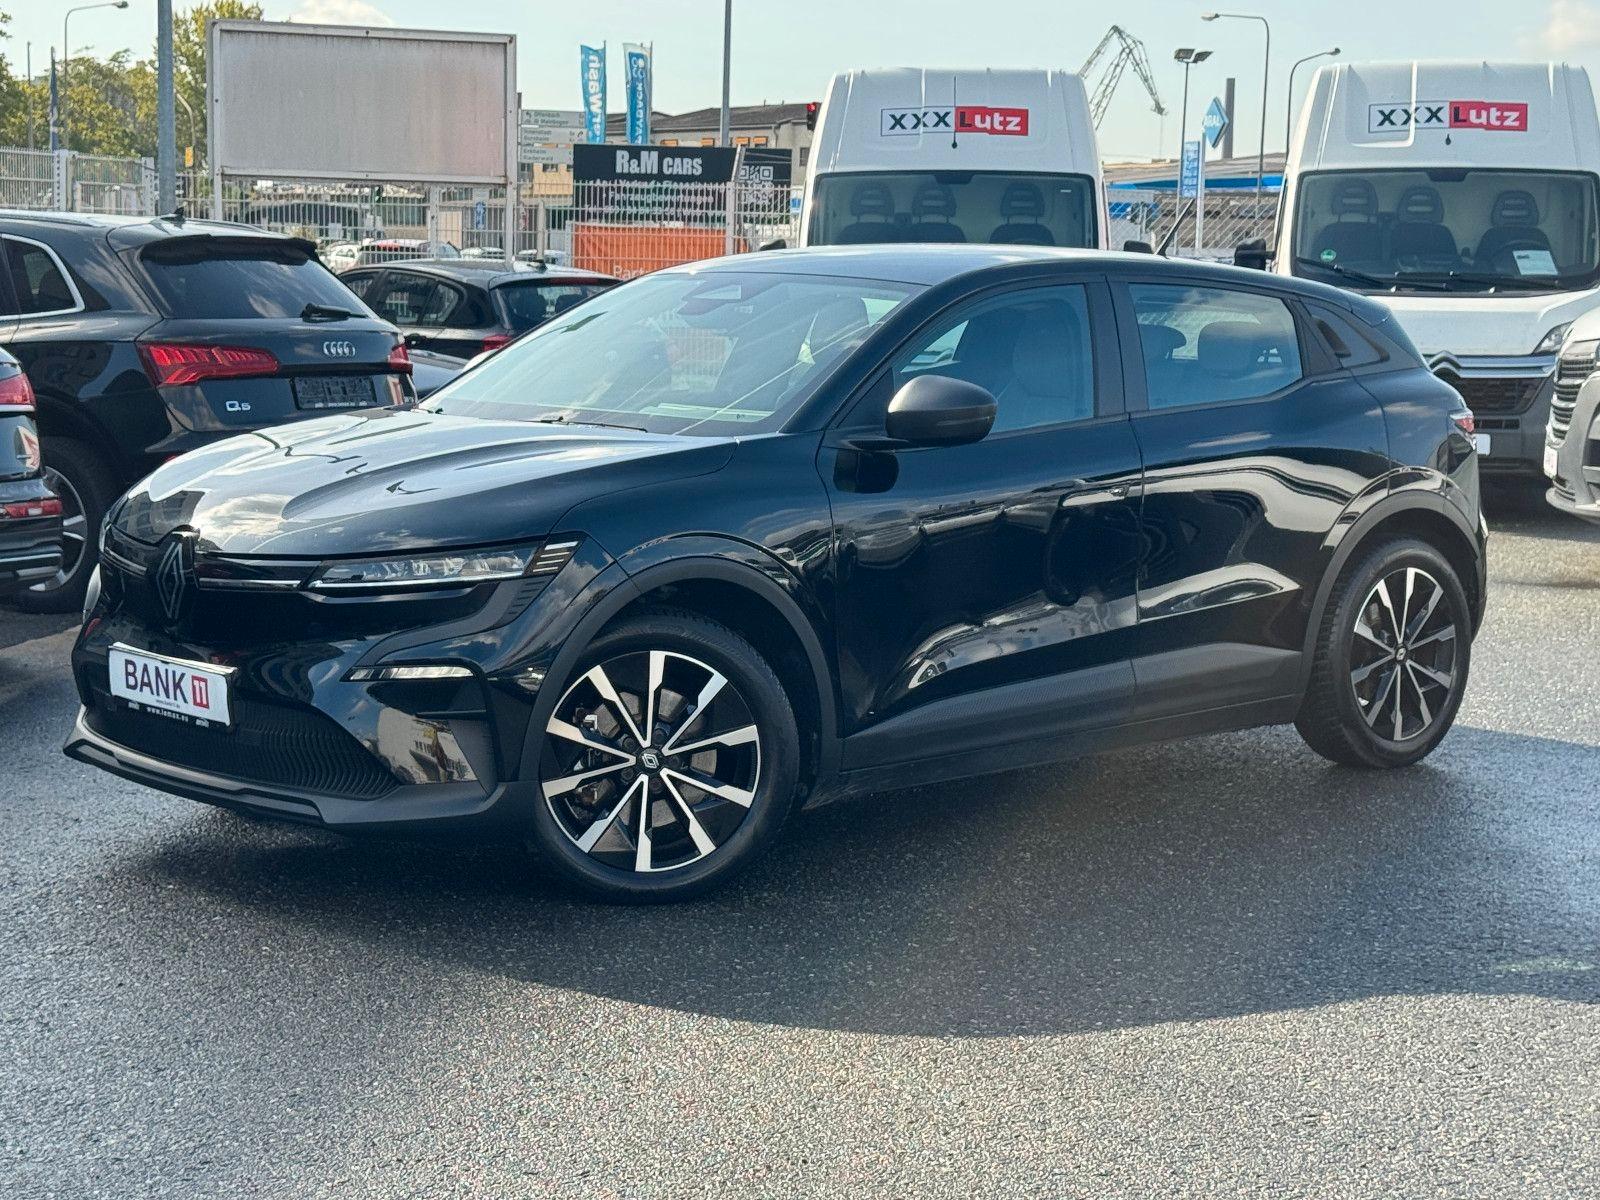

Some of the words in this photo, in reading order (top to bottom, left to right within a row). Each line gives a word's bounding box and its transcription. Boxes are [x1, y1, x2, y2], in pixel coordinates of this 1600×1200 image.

[888, 110, 1022, 132] XXXLutz
[1376, 105, 1520, 127] XXXLutz
[615, 149, 659, 175] R&M
[662, 157, 703, 176] CARS
[225, 400, 251, 413] Q5
[124, 658, 188, 704] BANK
